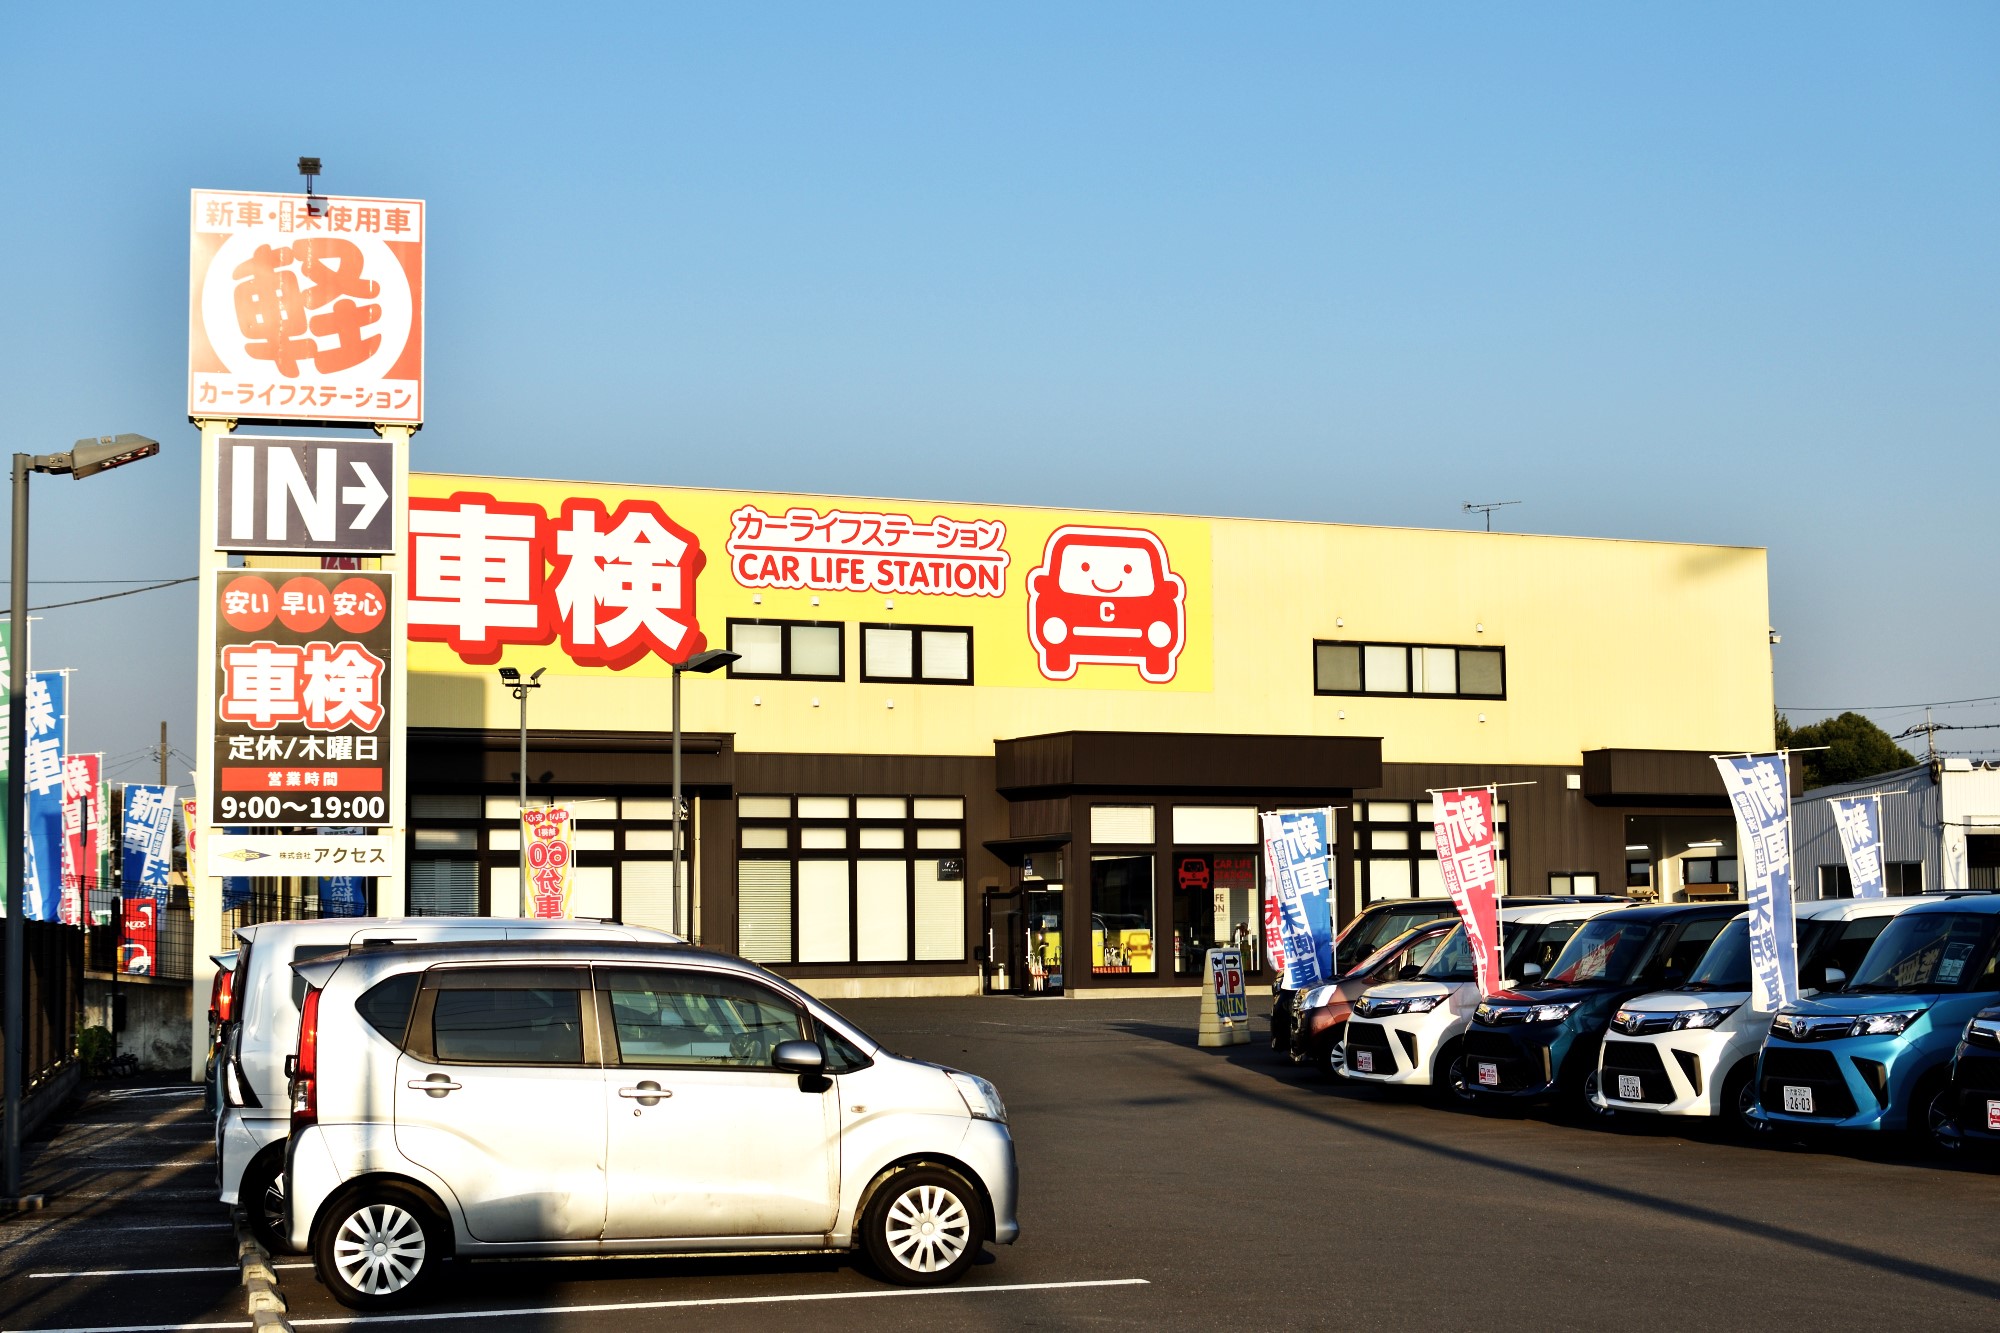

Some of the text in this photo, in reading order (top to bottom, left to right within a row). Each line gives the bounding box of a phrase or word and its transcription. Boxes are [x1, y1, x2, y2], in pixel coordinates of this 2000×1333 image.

[232, 238, 382, 378] 軽
[200, 382, 411, 409] カーライフステーション
[231, 446, 337, 541] IN
[738, 513, 999, 550] カーライフステーション
[407, 498, 695, 656] 車検
[739, 554, 999, 590] CAR LIFE STATION
[225, 590, 382, 616] 安い 早い 安心
[1100, 601, 1115, 622] C
[224, 645, 381, 730] 車検
[228, 735, 378, 760] 定休/木曜日
[268, 772, 338, 786] 営業時間
[124, 788, 163, 854] 新車
[279, 847, 385, 864] 株式会社 アクセス
[1216, 971, 1223, 994] P
[1228, 970, 1240, 993] P
[1229, 998, 1244, 1014] IN
[1790, 1096, 1811, 1111] 26-03
